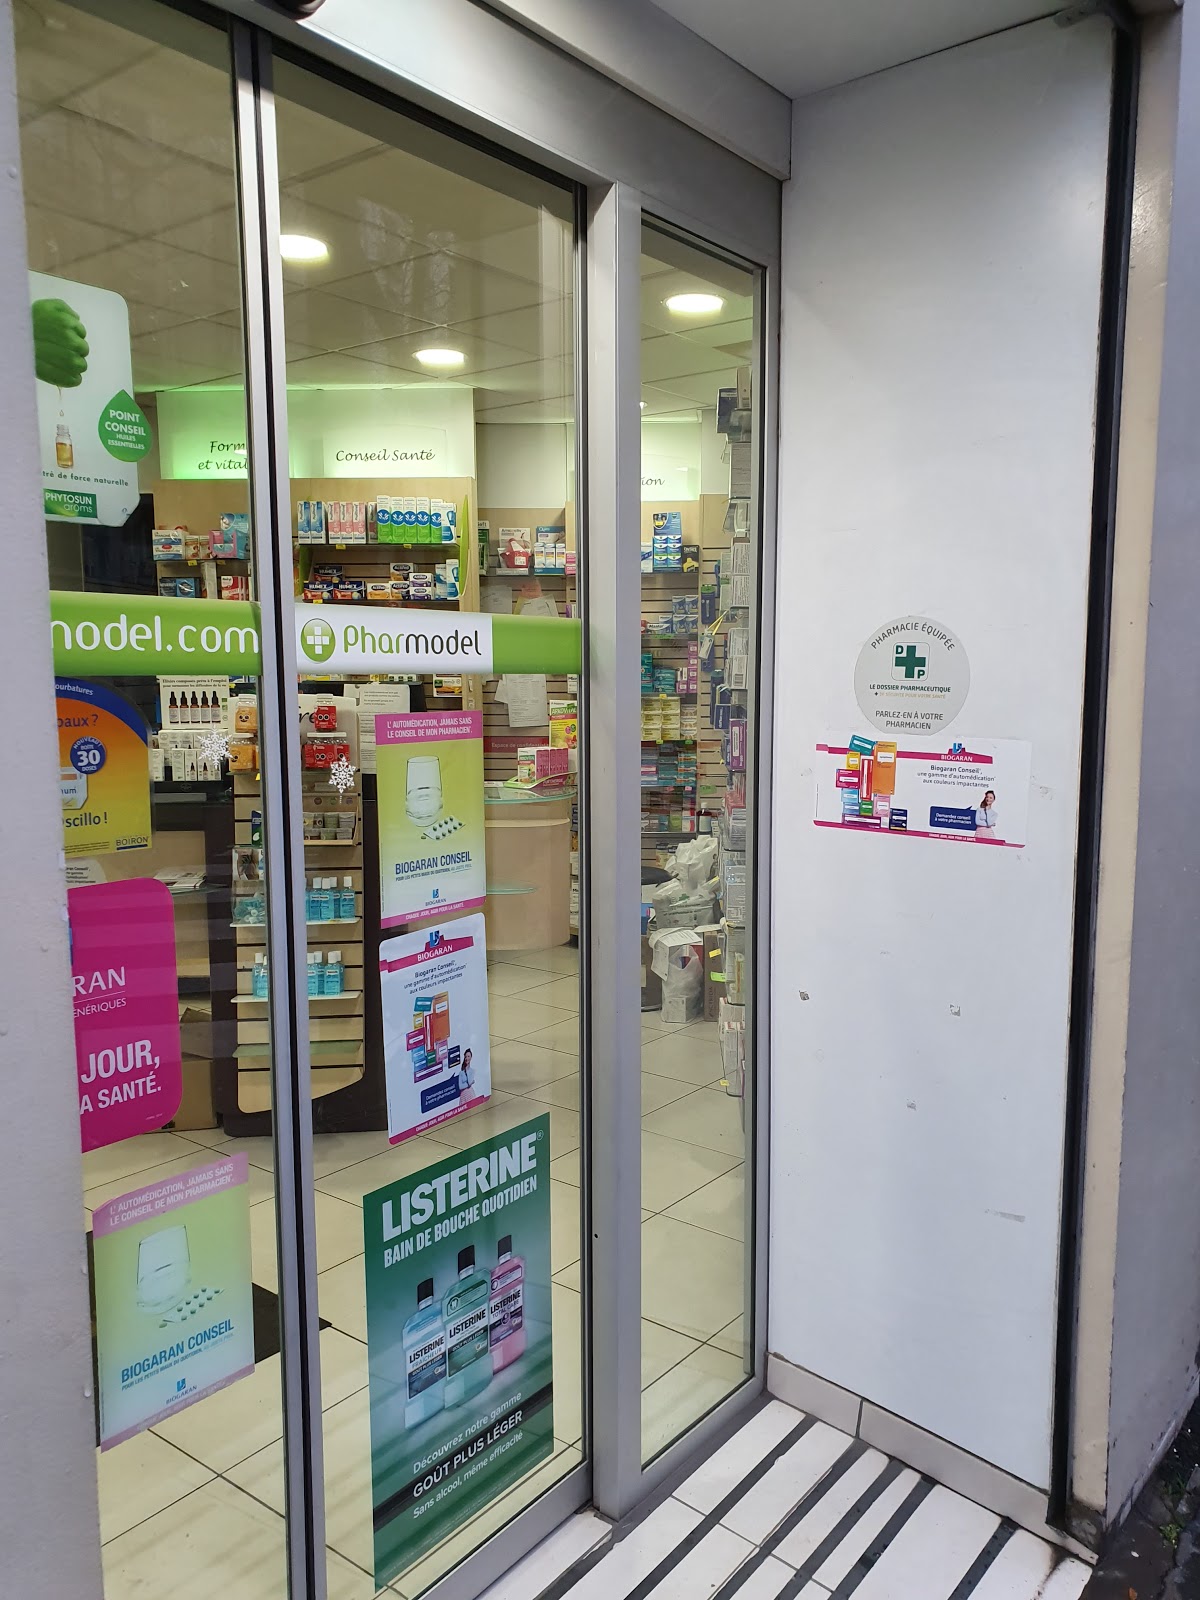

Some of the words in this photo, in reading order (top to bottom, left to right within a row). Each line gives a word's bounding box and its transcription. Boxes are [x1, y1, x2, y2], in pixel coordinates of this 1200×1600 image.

[109, 409, 140, 423] POINT
[104, 421, 146, 436] CONSEIL
[335, 448, 391, 462] Conseil
[391, 448, 436, 462] Santé
[198, 459, 214, 470] et
[57, 471, 68, 480] de
[70, 472, 91, 483] force
[93, 477, 129, 487] naturelle
[45, 492, 93, 505] PHYTOSUN
[343, 624, 482, 656] Pharmodel
[870, 622, 920, 650] PHARMACIE
[920, 621, 956, 652] ÉQUIPÉE
[895, 644, 904, 655] D
[917, 669, 926, 679] P
[900, 685, 951, 693] PHARMACEUTIQUE
[392, 718, 438, 729] AUTOMÉDICATION,
[439, 717, 458, 726] JAMAIS
[458, 716, 473, 725] SANS
[875, 710, 913, 719] PARLEZ-EN
[913, 710, 919, 720] À
[920, 712, 944, 721] VOTRE
[387, 730, 394, 739] LE
[394, 728, 418, 738] CONSEIL
[417, 728, 425, 737] DE
[425, 727, 438, 736] MON
[885, 720, 932, 730] PHARMACIEN
[77, 749, 101, 767] 30
[940, 754, 973, 762] BIOGARAN
[930, 764, 957, 773] Biogaran
[956, 780, 990, 788] impactantes
[62, 812, 102, 828] scillo
[115, 836, 149, 847] BOIRON
[395, 856, 438, 875] BIOGARAN
[440, 850, 473, 867] CONSEIL
[425, 898, 447, 907] BIOGARAN
[417, 944, 453, 962] BIOGARAN
[414, 967, 437, 979] Biogaran
[418, 981, 437, 992] couleurs
[437, 972, 463, 985] impactantes
[80, 1039, 161, 1084] JOUR,
[79, 1094, 94, 1116] A
[97, 1069, 162, 1110] SANTÉ.
[117, 1180, 185, 1213] AUTOMÉDICATION,
[186, 1171, 214, 1188] JAMAIS
[214, 1163, 234, 1177] SANS
[382, 1131, 537, 1243] LISTERINE
[110, 1215, 120, 1227] LE
[121, 1205, 153, 1222] CONSEIL
[154, 1199, 166, 1209] DE
[166, 1193, 184, 1207] MON
[383, 1237, 414, 1269] BAIN
[416, 1227, 433, 1252] DE
[434, 1202, 481, 1243] BOUCHE
[481, 1174, 538, 1218] QUOTIDIEN
[490, 1289, 521, 1315] LISTERINE
[492, 1307, 508, 1319] TOTAL
[449, 1308, 486, 1339] LISTERINE
[121, 1340, 185, 1384] BIOGARAN
[187, 1318, 235, 1351] CONSEIL
[409, 1335, 445, 1364] LISTERINE
[165, 1384, 198, 1405] BIOGARAN
[413, 1433, 463, 1475] Découvrez
[465, 1415, 489, 1438] notre
[490, 1392, 522, 1421] gamme
[413, 1461, 451, 1498] GOÛT
[453, 1437, 485, 1469] PLUS
[487, 1410, 523, 1445] LÉGER
[413, 1497, 435, 1519] Sans
[435, 1476, 463, 1502] alcool,
[463, 1457, 489, 1481] même
[489, 1431, 524, 1462] efficacité
